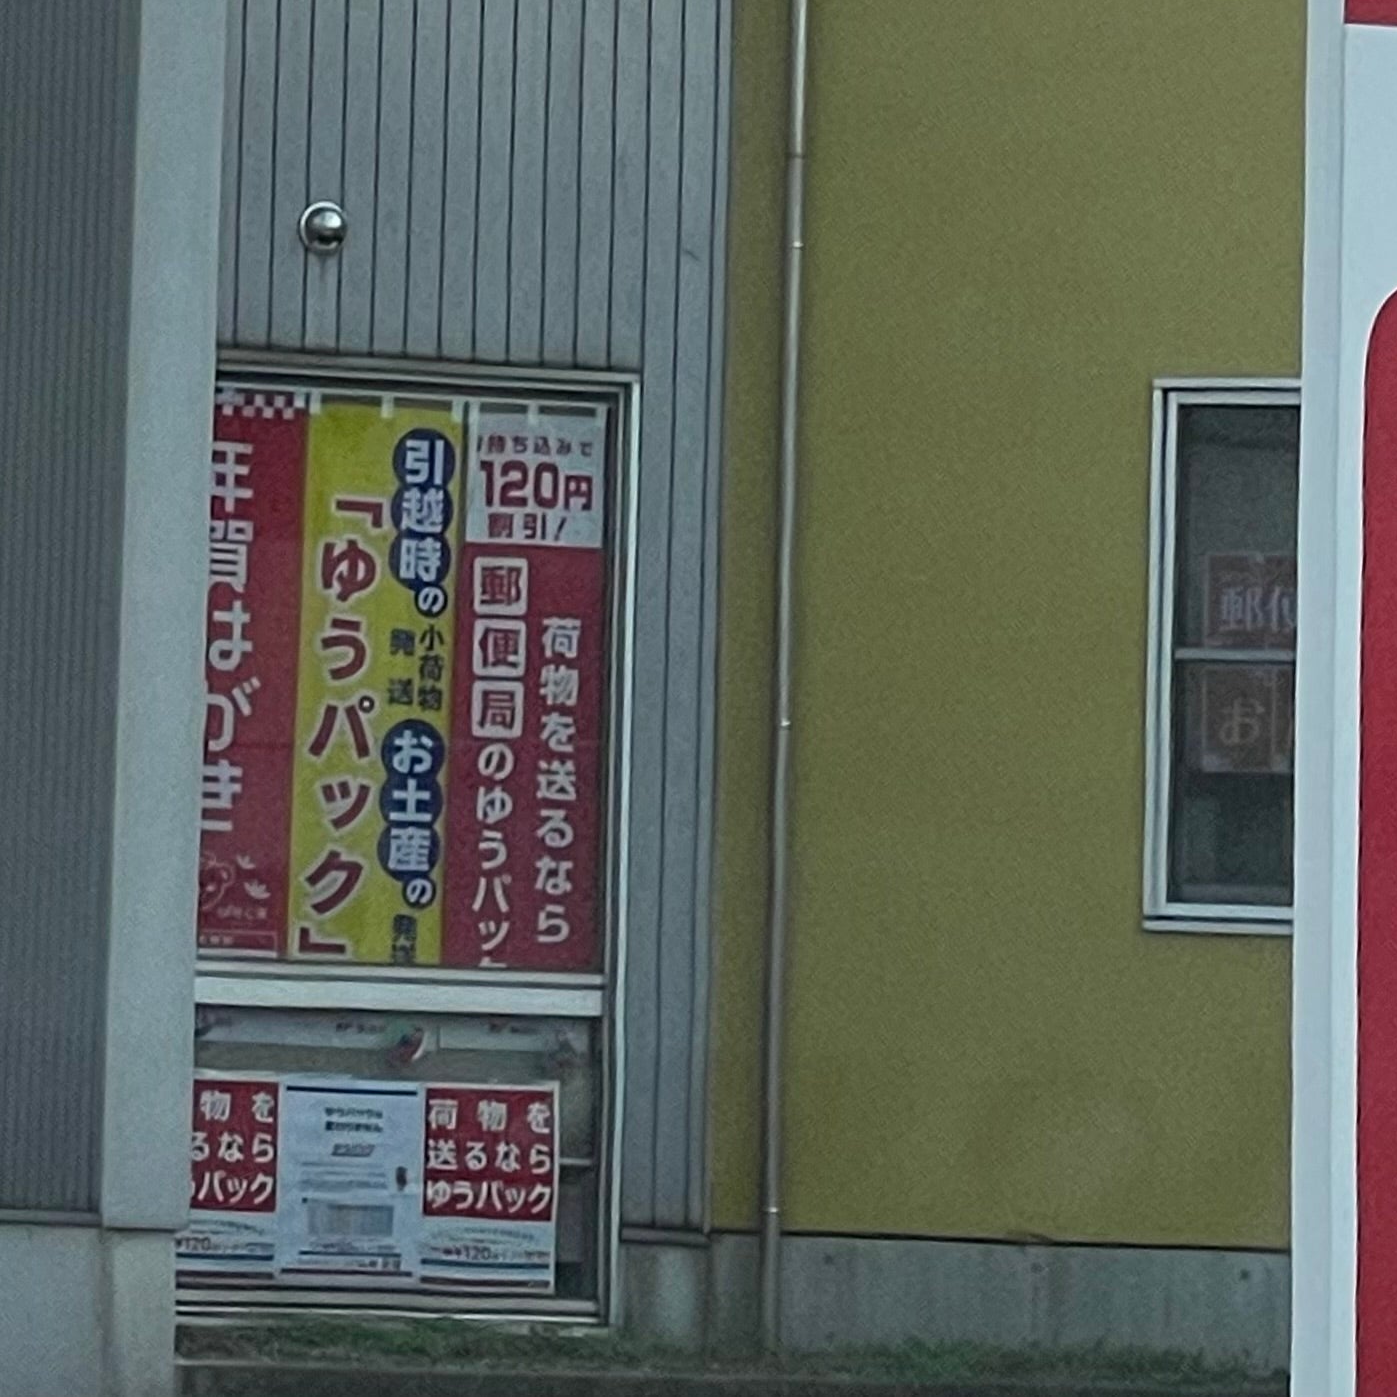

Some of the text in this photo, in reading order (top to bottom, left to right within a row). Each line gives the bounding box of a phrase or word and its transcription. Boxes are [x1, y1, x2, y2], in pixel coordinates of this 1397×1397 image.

[479, 460, 593, 511] 120円
[399, 439, 446, 613] 引越時の
[535, 616, 582, 943] 荷物を送るなら
[387, 729, 433, 904] お土産の
[428, 1099, 551, 1134] 荷物を
[427, 1139, 551, 1175] 送るなら
[426, 1180, 551, 1214] ゆうパック
